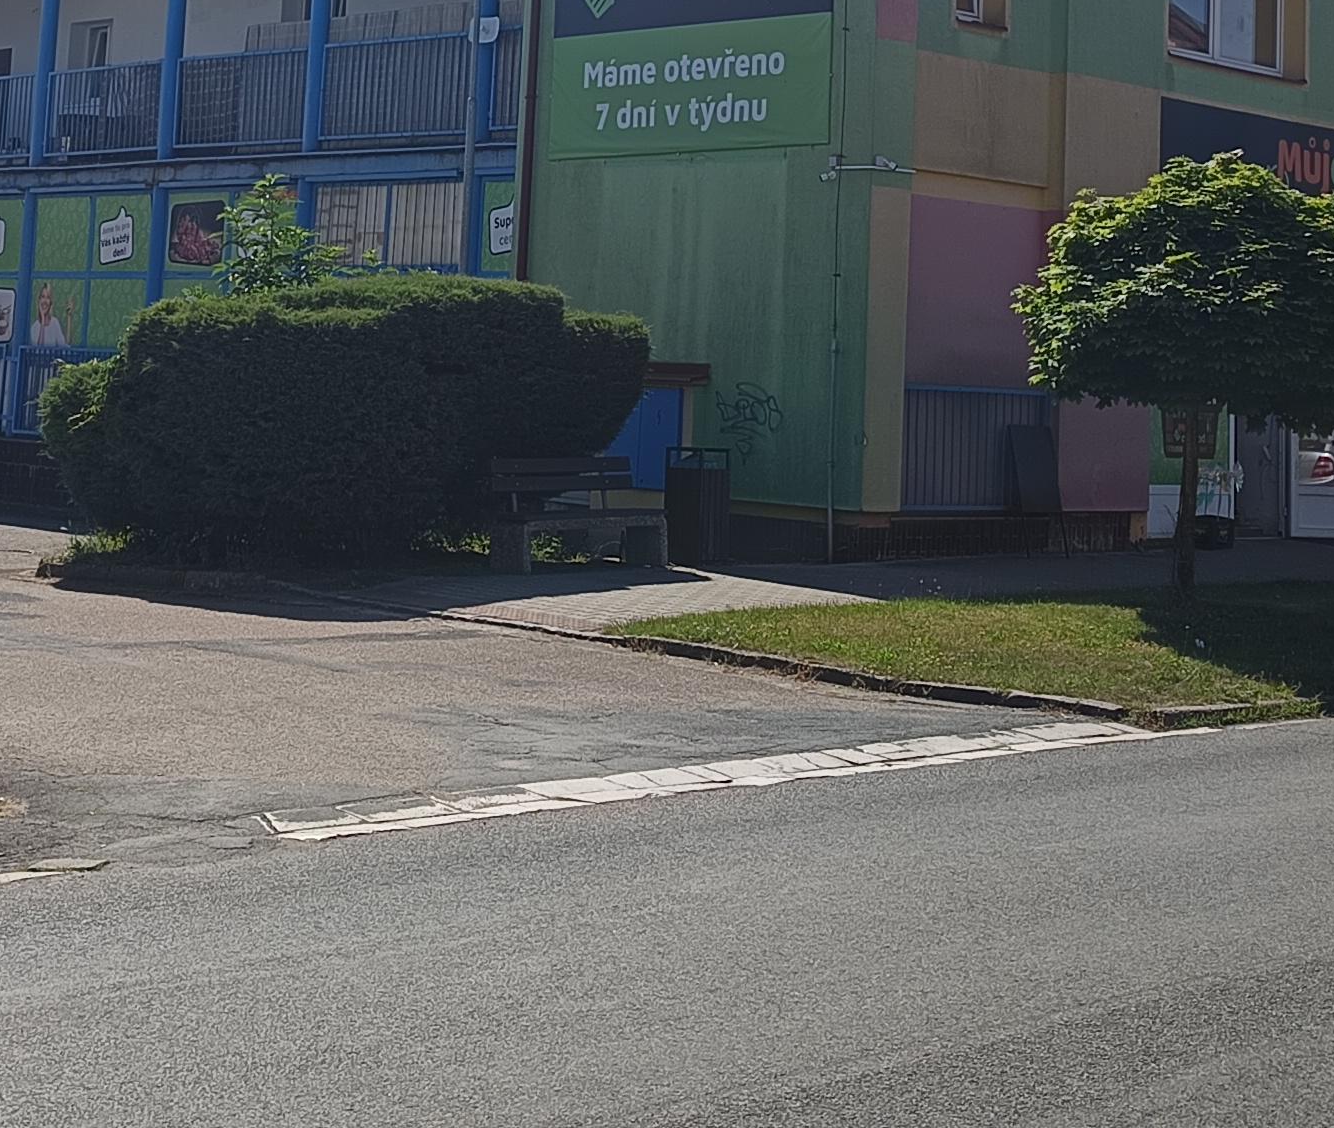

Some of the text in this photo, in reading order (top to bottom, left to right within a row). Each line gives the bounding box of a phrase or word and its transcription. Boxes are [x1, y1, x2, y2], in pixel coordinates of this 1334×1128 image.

[583, 48, 785, 89] Máme otevřeno
[596, 92, 767, 132] 7 dní v týdnu
